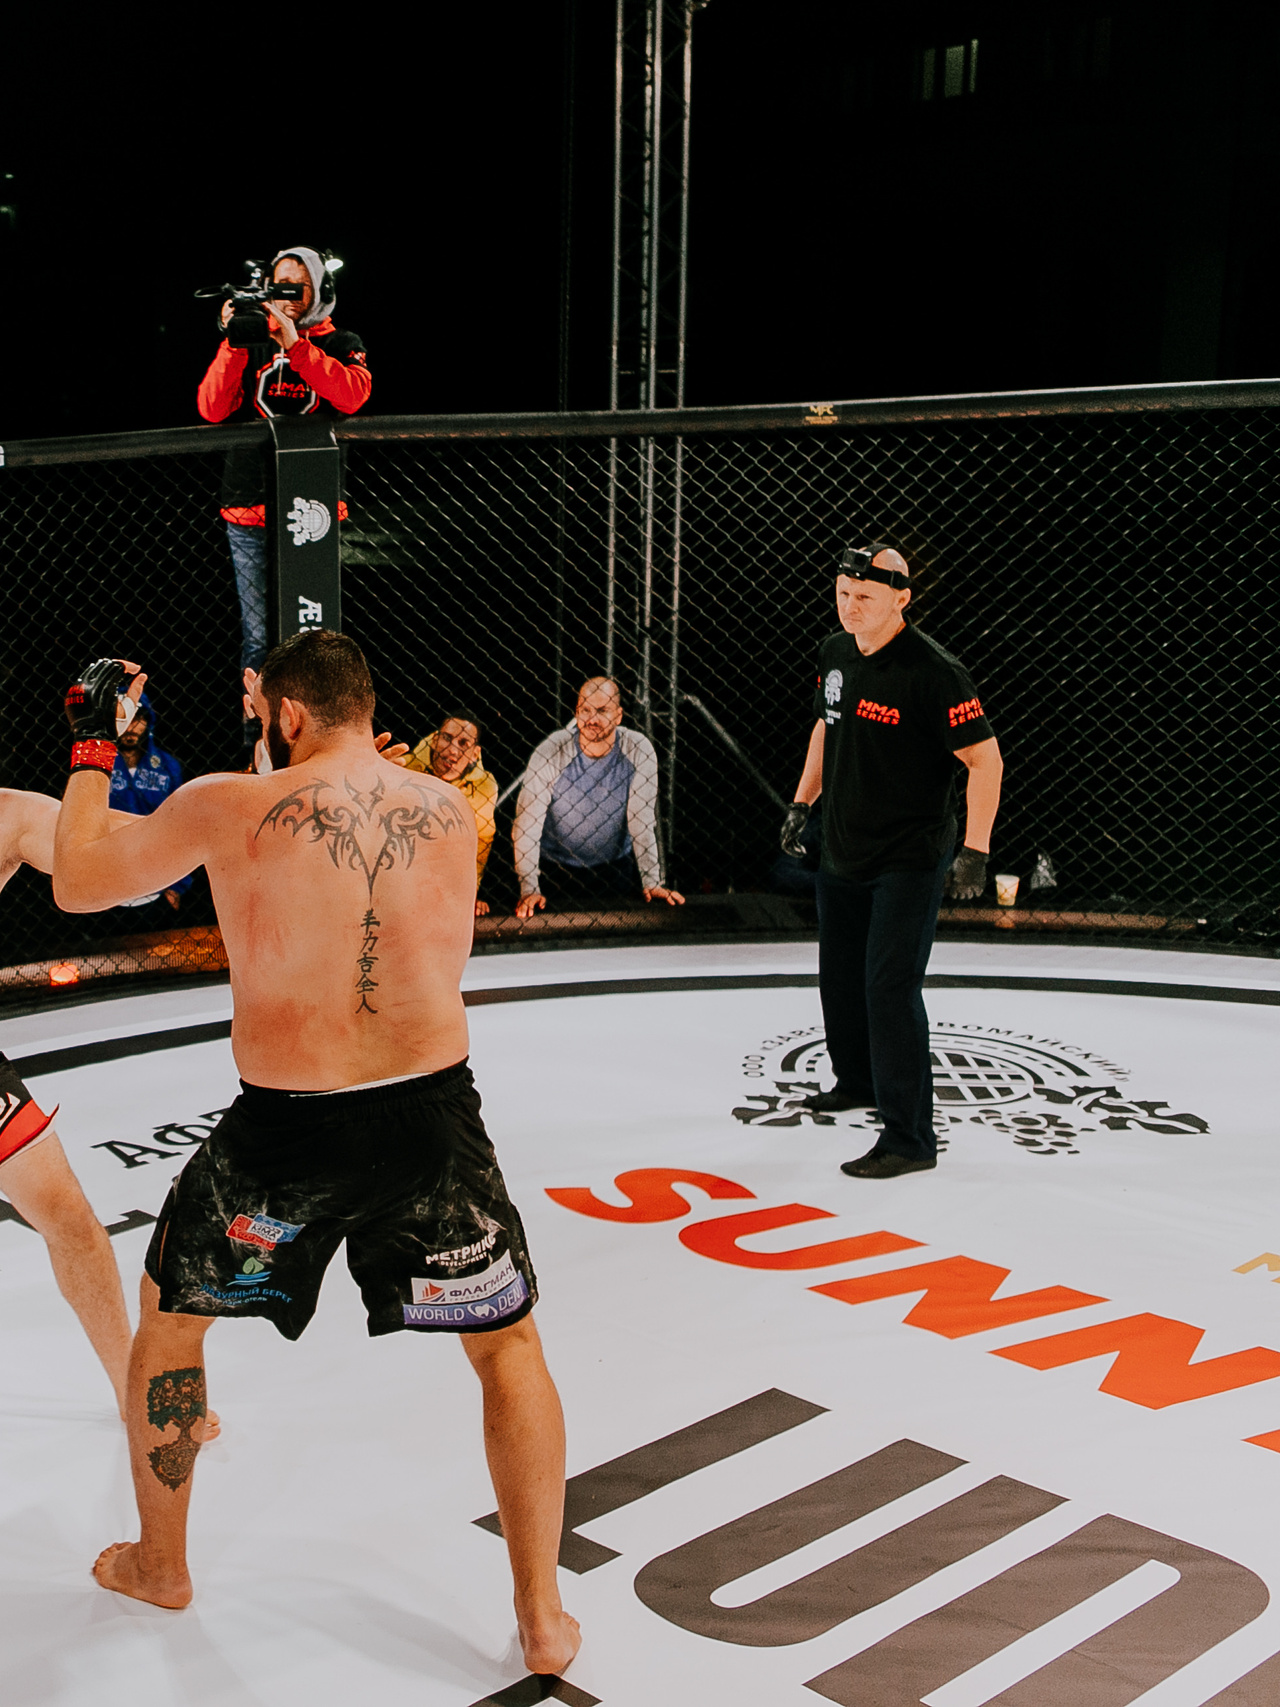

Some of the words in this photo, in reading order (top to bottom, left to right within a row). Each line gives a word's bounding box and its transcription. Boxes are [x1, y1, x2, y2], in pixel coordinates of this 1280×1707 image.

[856, 708, 899, 725] SERIES
[858, 699, 900, 719] MMA
[950, 707, 984, 727] SERIE
[449, 1262, 513, 1297] ФЛАГМАН
[200, 1283, 260, 1300] ЛАЗУРНЫЙ
[261, 1288, 293, 1304] БЕРЕГ
[408, 1307, 465, 1321] WORLD
[543, 1167, 1280, 1453] SUNN
